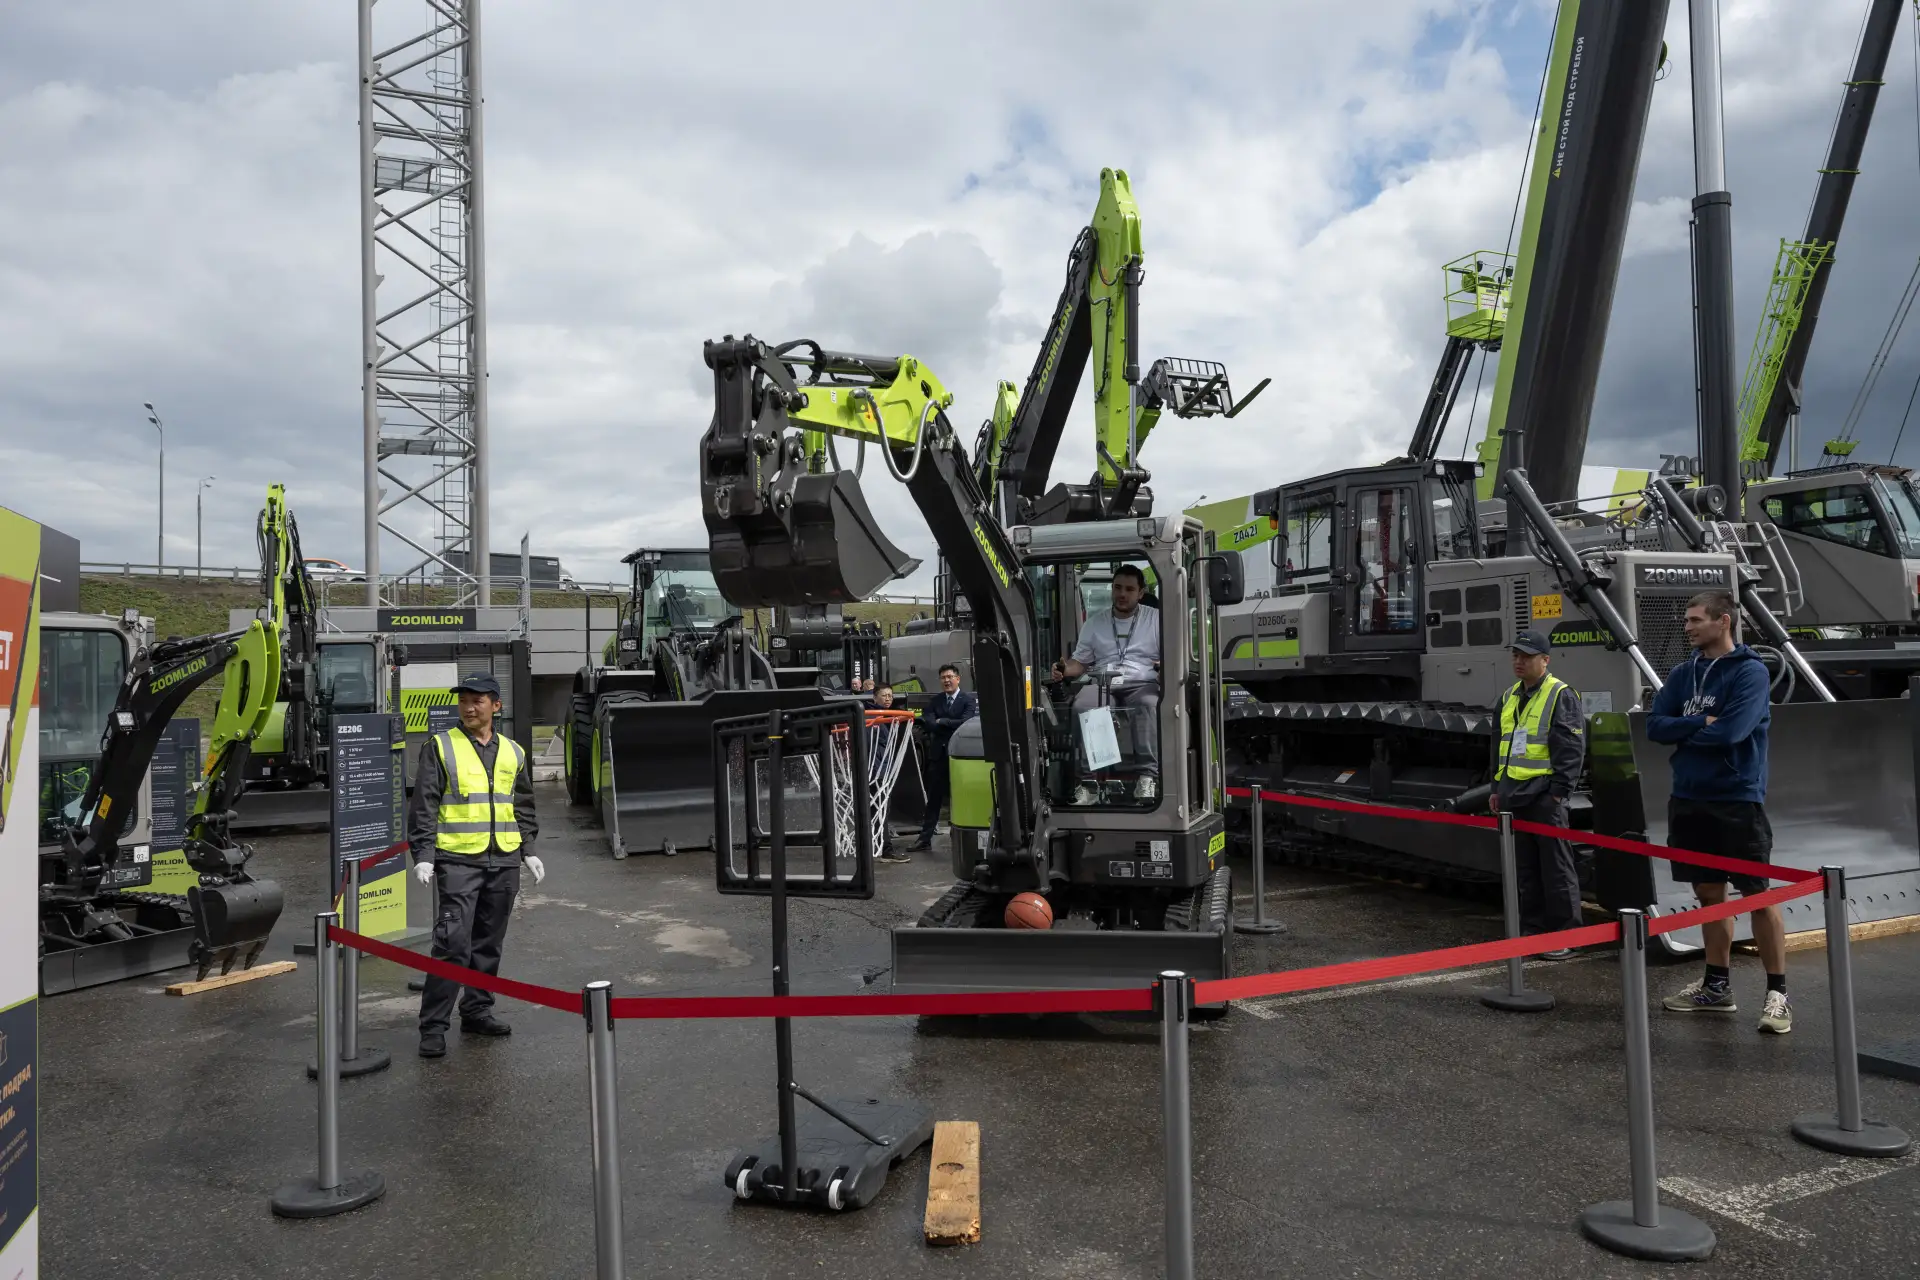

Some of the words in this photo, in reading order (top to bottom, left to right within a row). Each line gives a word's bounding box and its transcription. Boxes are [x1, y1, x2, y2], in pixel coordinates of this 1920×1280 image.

[1569, 36, 1585, 90] СТРЕЛОЙ
[1565, 92, 1576, 117] ПОД
[1559, 119, 1570, 149] СТОЙ
[1556, 151, 1565, 167] НЕ
[1037, 302, 1073, 395] ZOOMLION
[1659, 454, 1769, 481] ZOOON
[1233, 524, 1258, 543] ZA42J
[974, 520, 1009, 589] ZOOMLION
[1644, 568, 1724, 584] ZOOMLION
[391, 615, 464, 626] ZOOMLION
[1257, 614, 1286, 627] ZD260G
[1552, 630, 1614, 644] ZOOMLIO
[150, 656, 207, 694] ZOOMLION
[337, 725, 362, 734] ZE20G
[392, 754, 402, 842] ZOOMLION
[136, 853, 144, 861] 93
[151, 858, 184, 866] OMLION
[1153, 850, 1164, 860] 93
[358, 887, 392, 901] OOMLION
